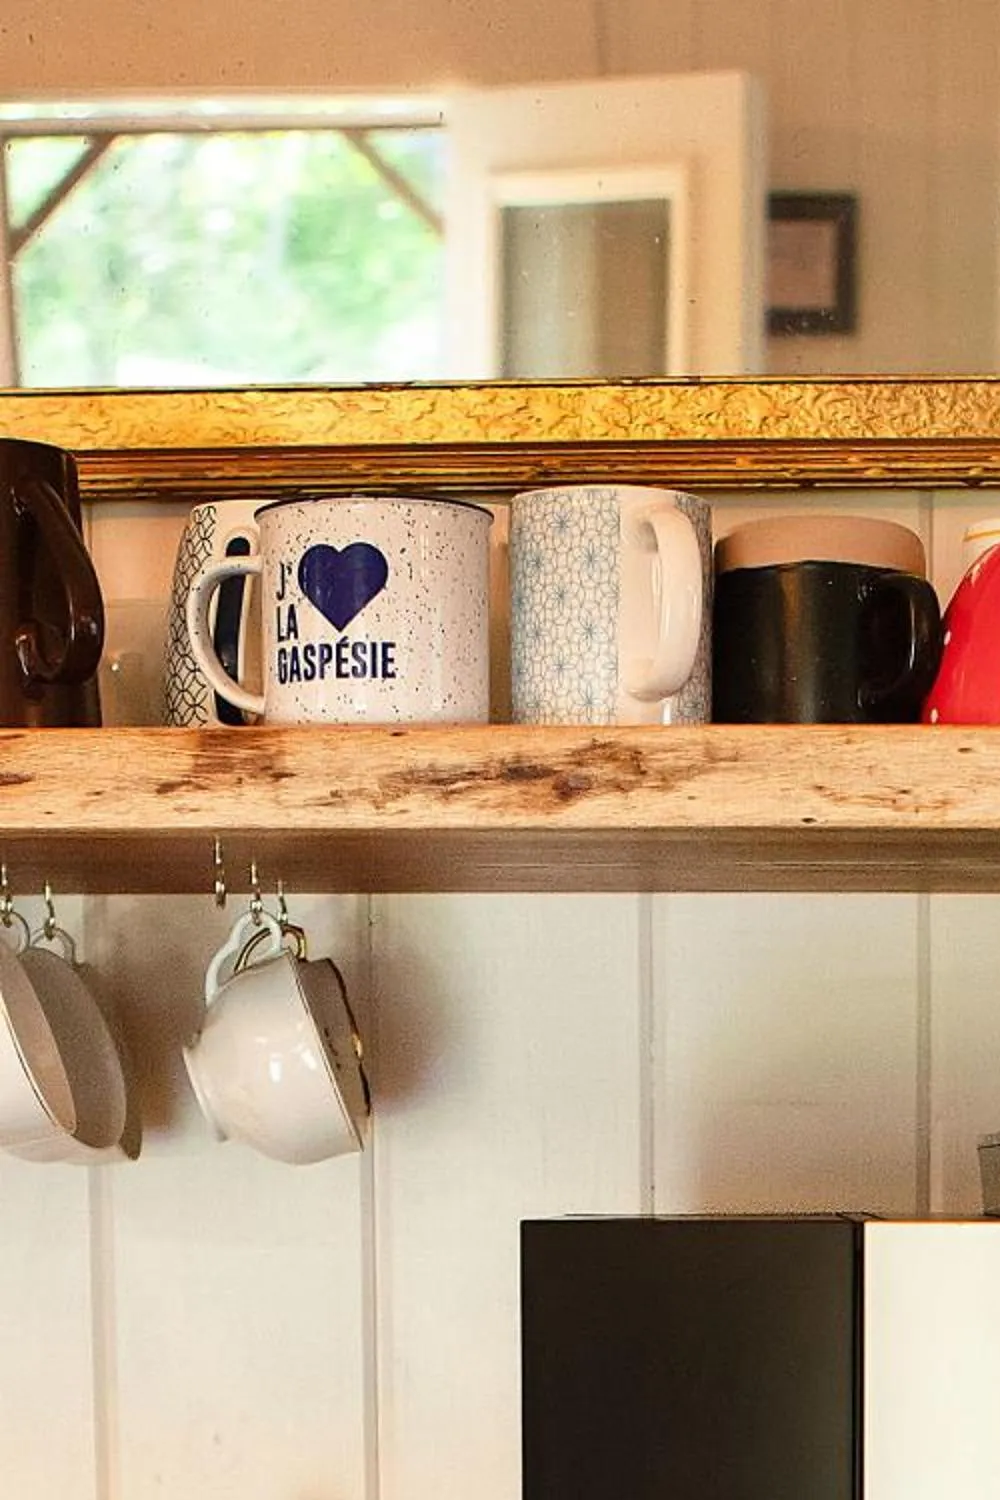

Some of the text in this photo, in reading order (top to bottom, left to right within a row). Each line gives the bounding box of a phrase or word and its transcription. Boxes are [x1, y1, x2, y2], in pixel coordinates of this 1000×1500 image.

[276, 561, 293, 601] J'
[276, 603, 299, 642] LA
[277, 635, 397, 685] GASPÉSIE
